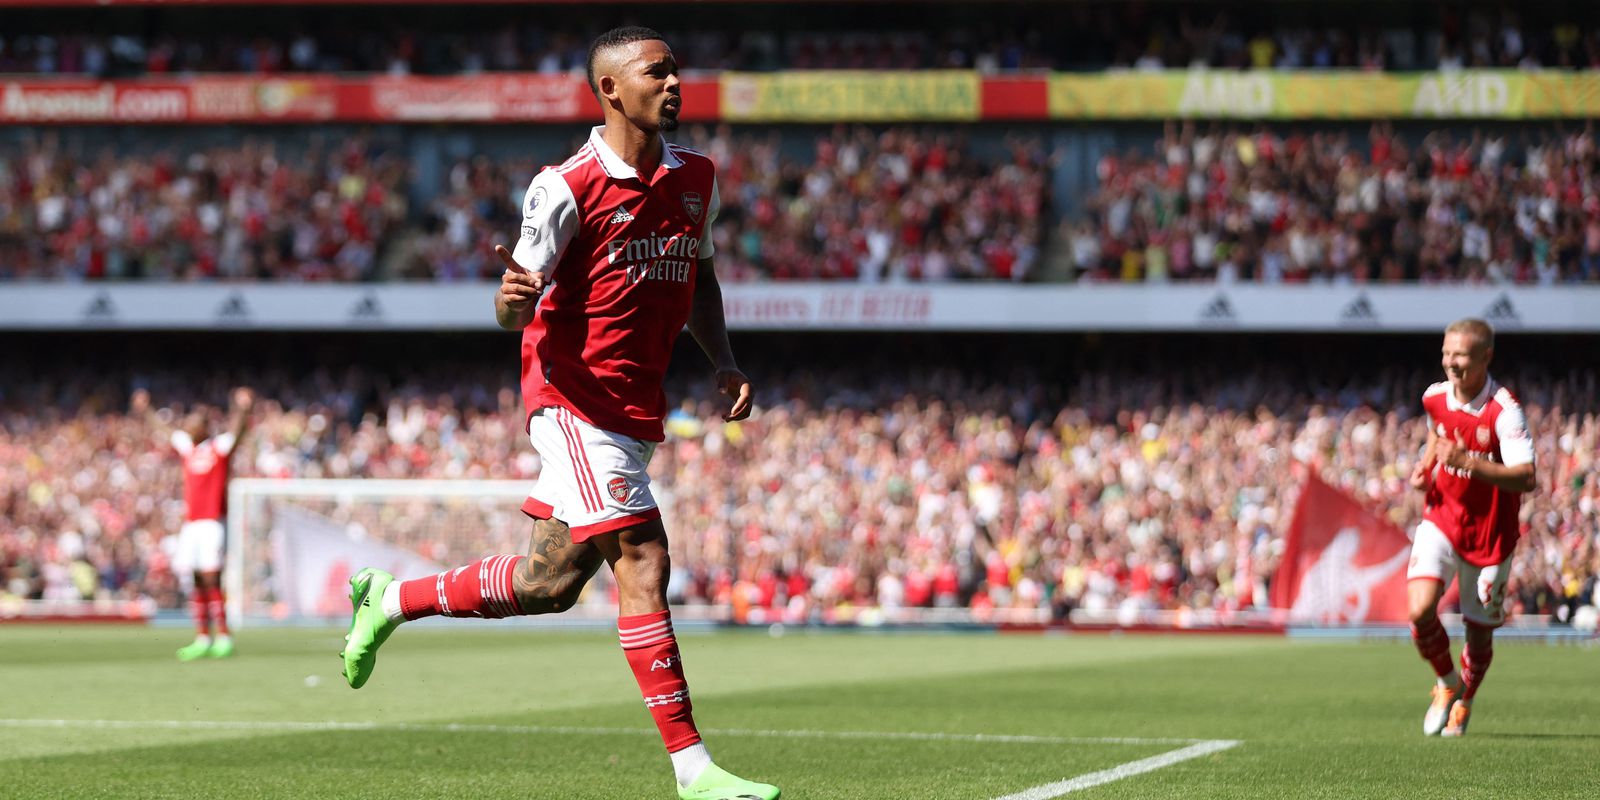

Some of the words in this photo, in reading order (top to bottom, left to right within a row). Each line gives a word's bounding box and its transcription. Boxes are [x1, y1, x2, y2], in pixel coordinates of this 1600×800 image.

[3, 83, 188, 119] Arsenal.com
[1178, 73, 1275, 117] AND
[1412, 73, 1510, 117] AND
[625, 262, 649, 285] FLY
[648, 260, 691, 283] BETTER
[725, 295, 811, 320] mirates
